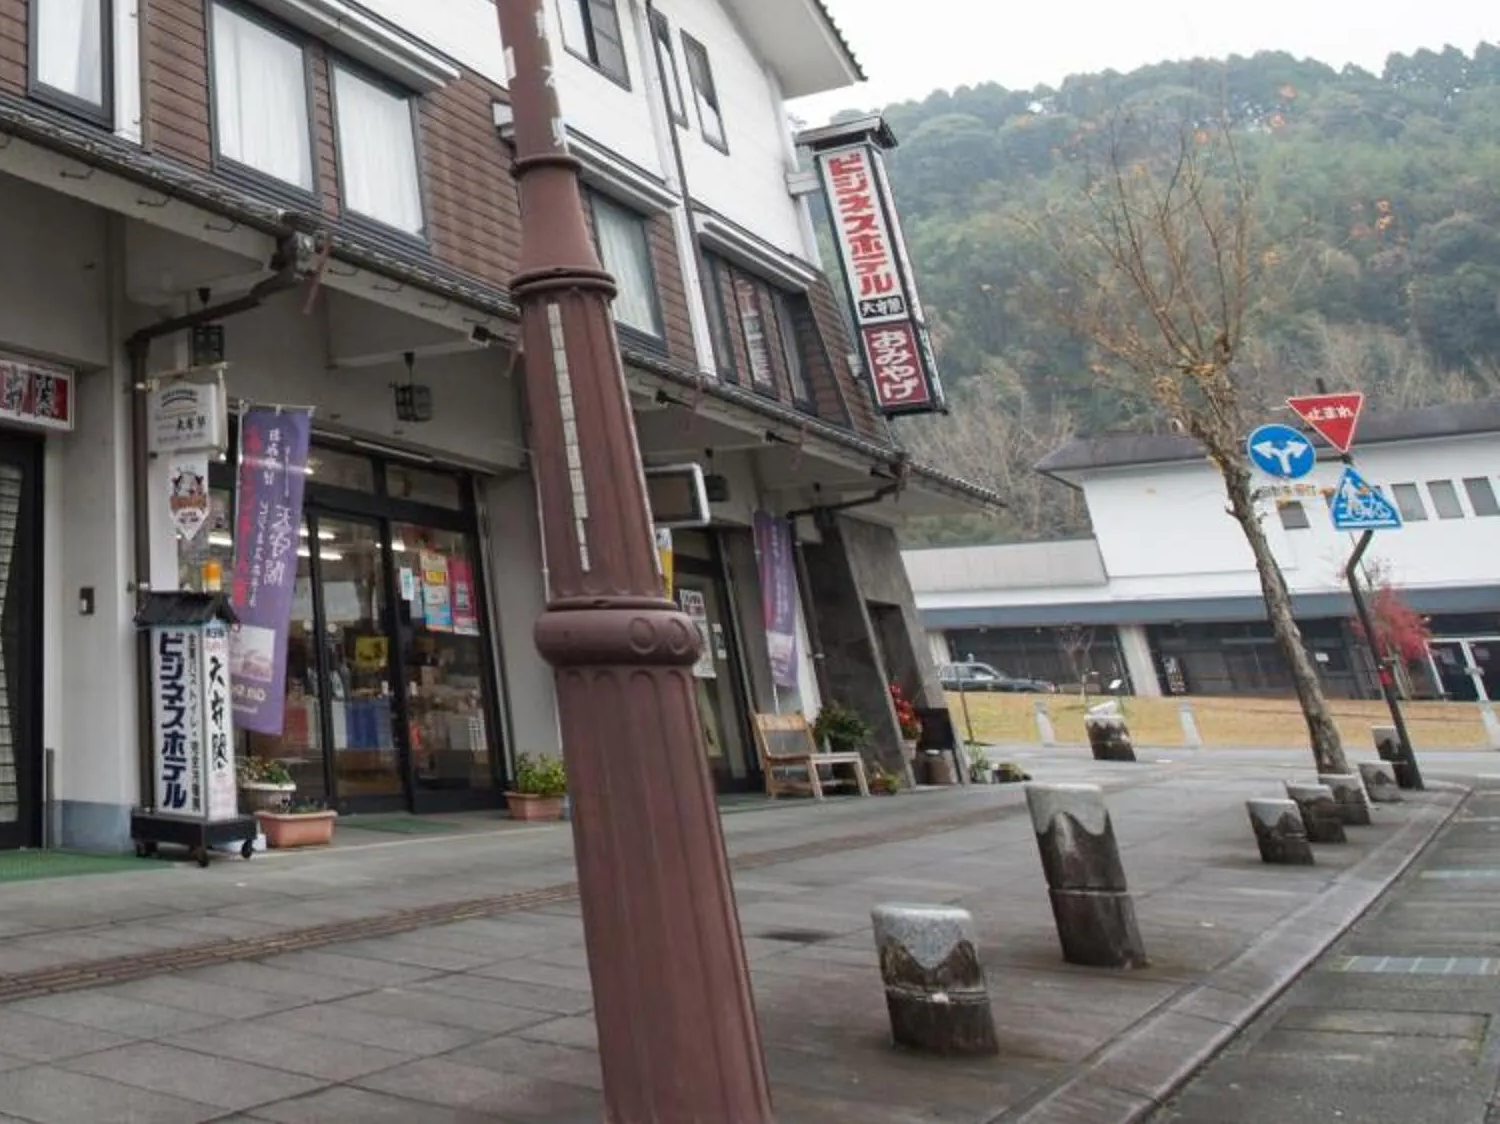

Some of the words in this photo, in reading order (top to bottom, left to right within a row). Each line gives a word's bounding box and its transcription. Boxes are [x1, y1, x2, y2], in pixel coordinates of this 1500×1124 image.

[827, 152, 894, 296] ビジネスホテル
[871, 330, 920, 399] おみやげ
[1307, 405, 1356, 421] 止まれ
[159, 631, 188, 810] ビジネスホテル
